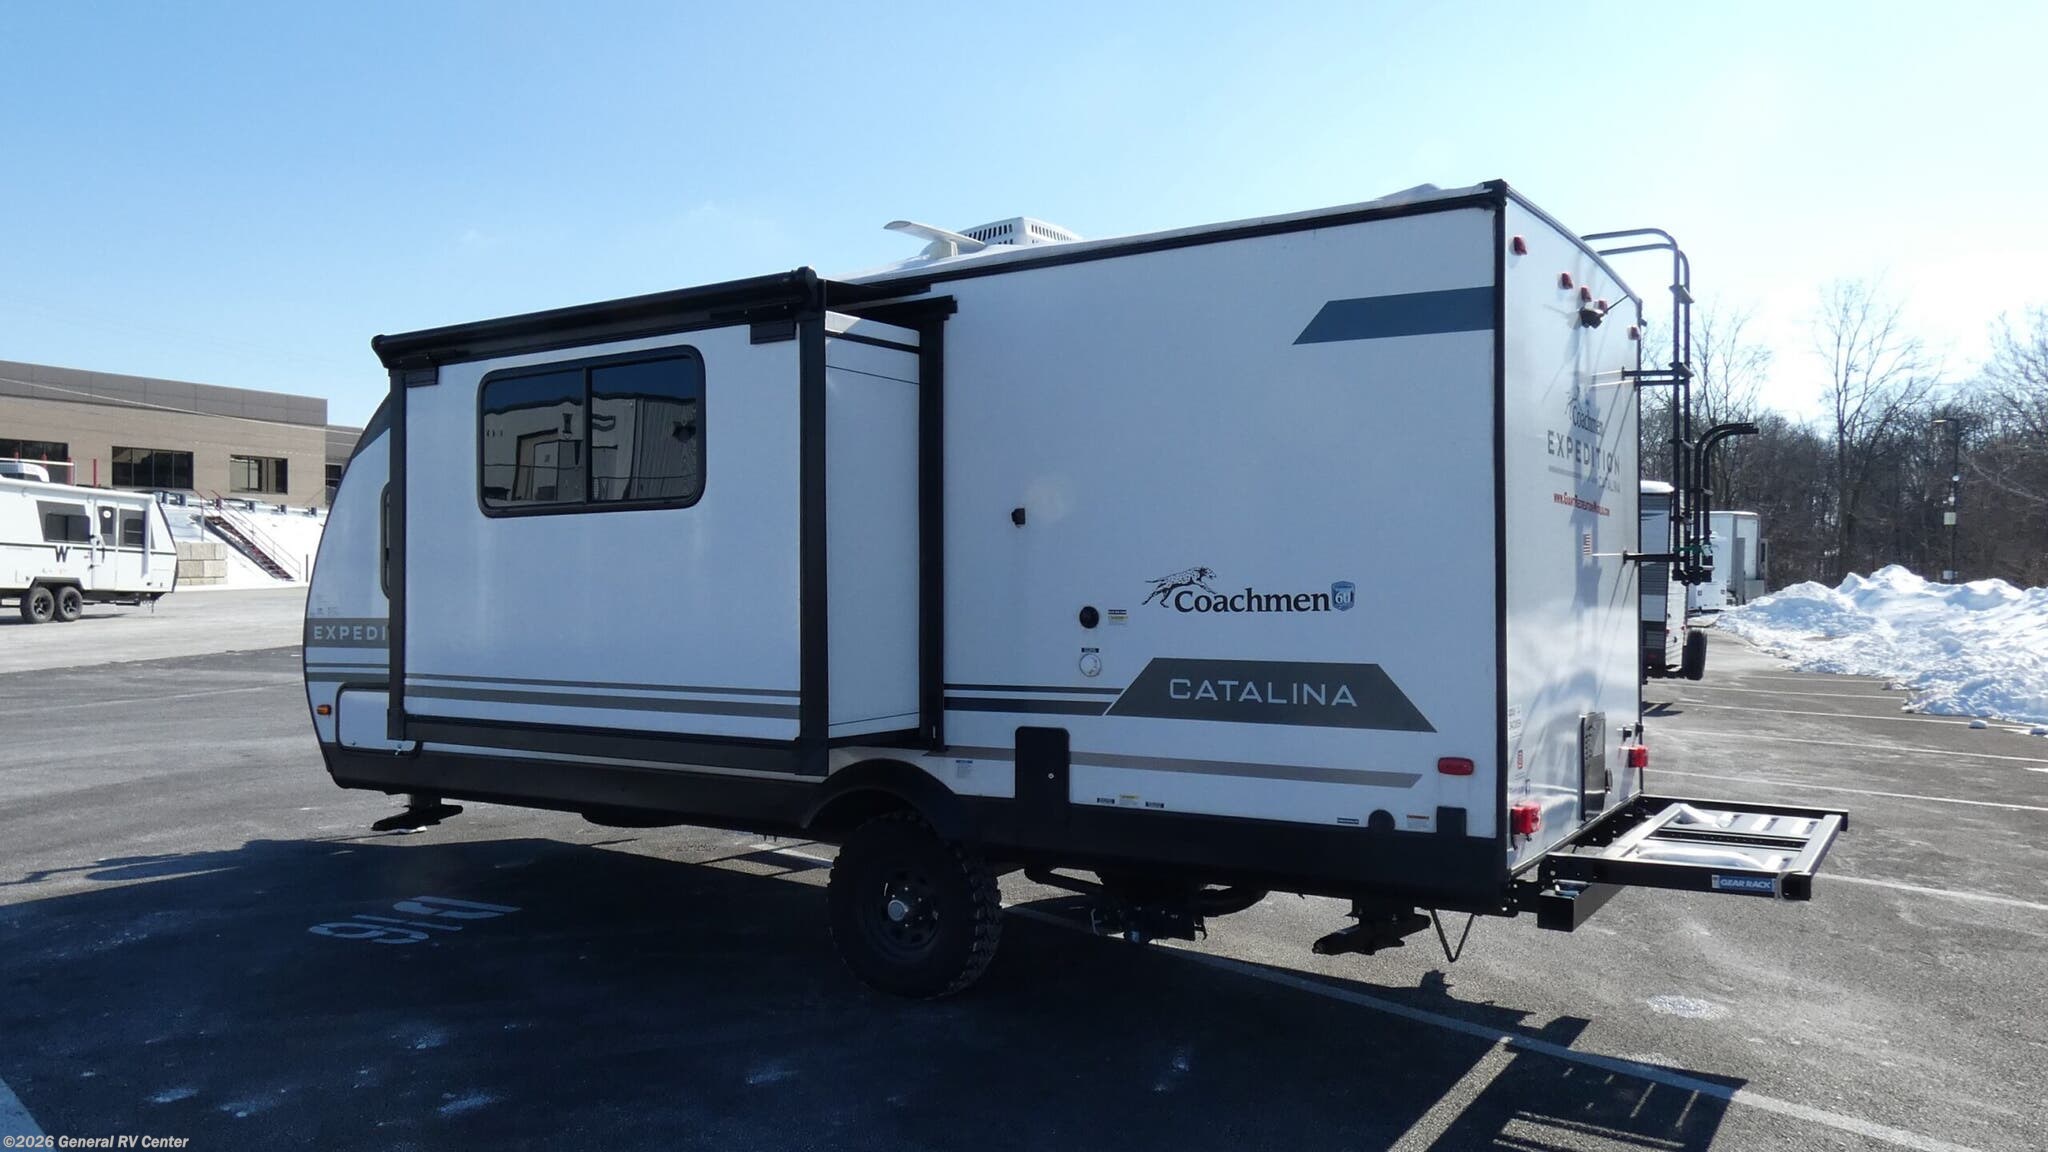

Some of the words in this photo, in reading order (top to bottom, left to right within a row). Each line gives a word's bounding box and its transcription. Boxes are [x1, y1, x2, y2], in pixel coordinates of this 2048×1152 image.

[1547, 429, 1621, 476] EXPEDITION
[1174, 587, 1331, 613] Coachmen
[313, 625, 386, 641] EXPEDI
[1169, 677, 1359, 708] CATALINA
[1720, 878, 1745, 887] GEAR
[1745, 880, 1771, 889] RACK
